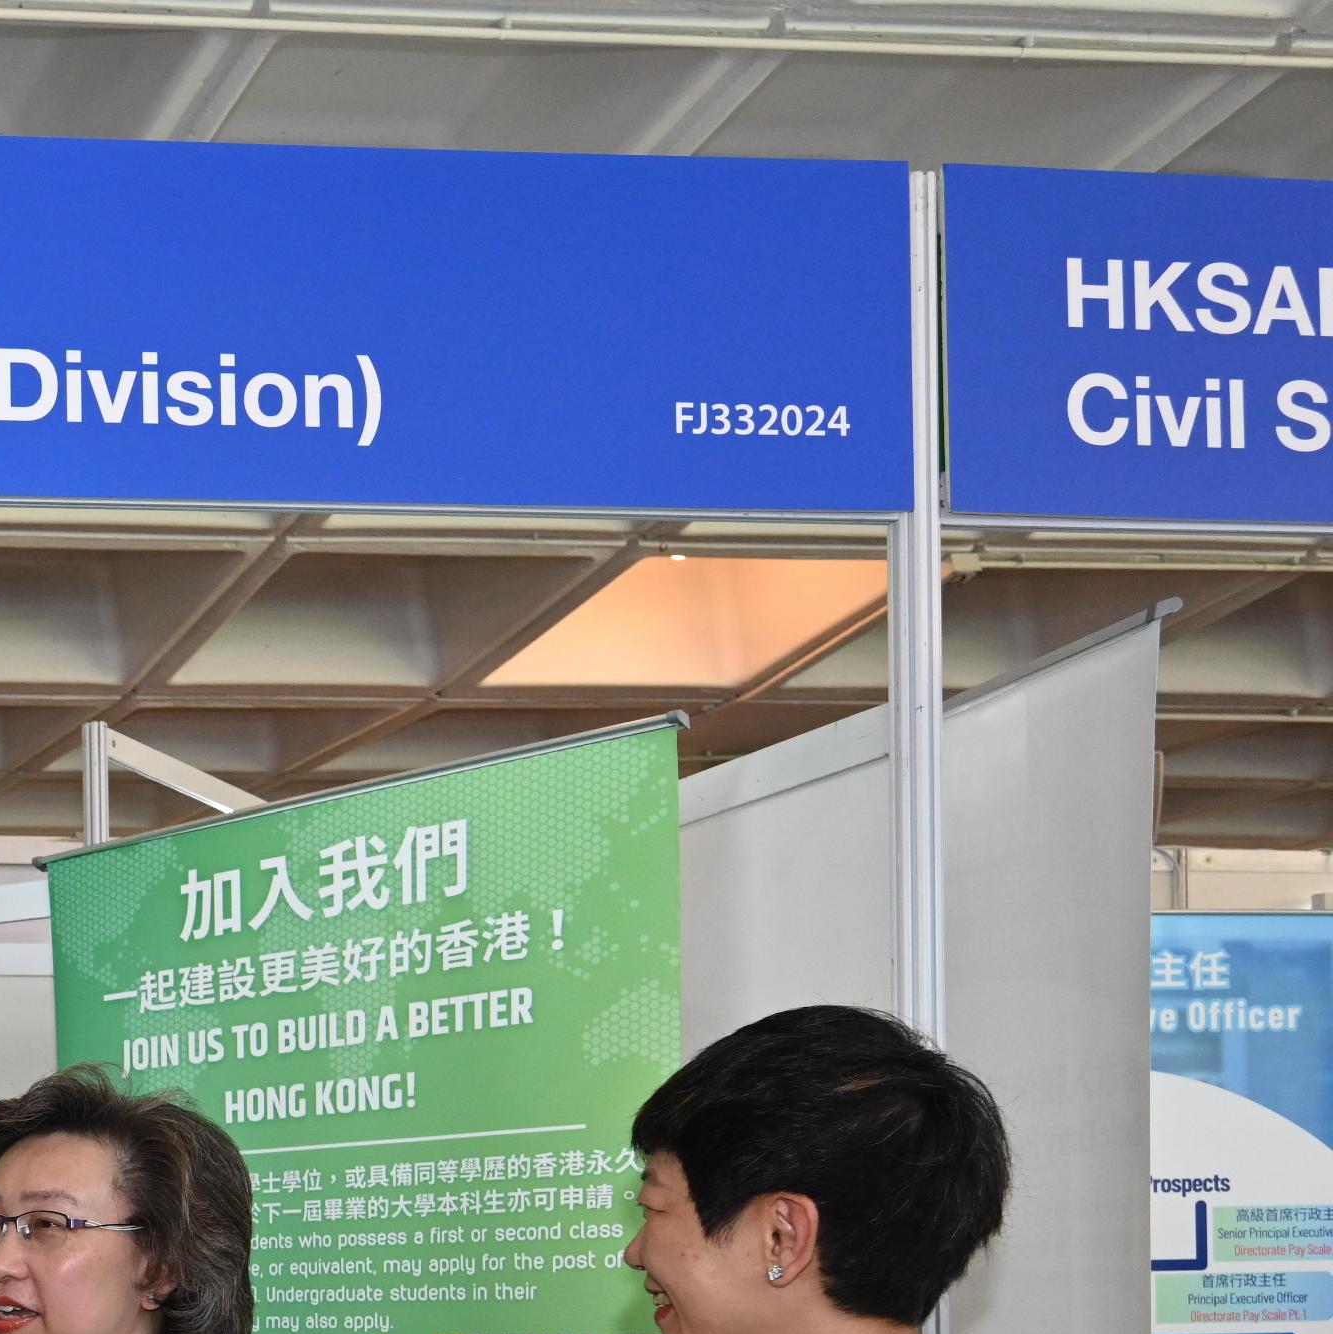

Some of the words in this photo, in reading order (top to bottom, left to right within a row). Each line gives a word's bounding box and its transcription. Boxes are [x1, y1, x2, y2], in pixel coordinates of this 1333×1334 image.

[1066, 258, 1333, 336] HKSA
[676, 402, 850, 437] FJ332024
[1067, 373, 1244, 449] Civil
[179, 819, 467, 942] 加入我們
[103, 909, 564, 1014] 一起建設更美好的香港！
[122, 1034, 179, 1078] JOIN
[188, 1029, 224, 1062] US
[234, 1023, 267, 1058] TO
[278, 1010, 365, 1053] BUILD
[376, 1005, 399, 1042] A
[408, 988, 532, 1038] BETTER
[1188, 998, 1301, 1030] Officer
[225, 1083, 305, 1124] HONG
[315, 1071, 416, 1117] KONG!
[1188, 1293, 1227, 1307] Principal
[1230, 1293, 1274, 1304] Executive
[1277, 1292, 1307, 1303] Officer
[1202, 1273, 1285, 1288] 首席行政主任
